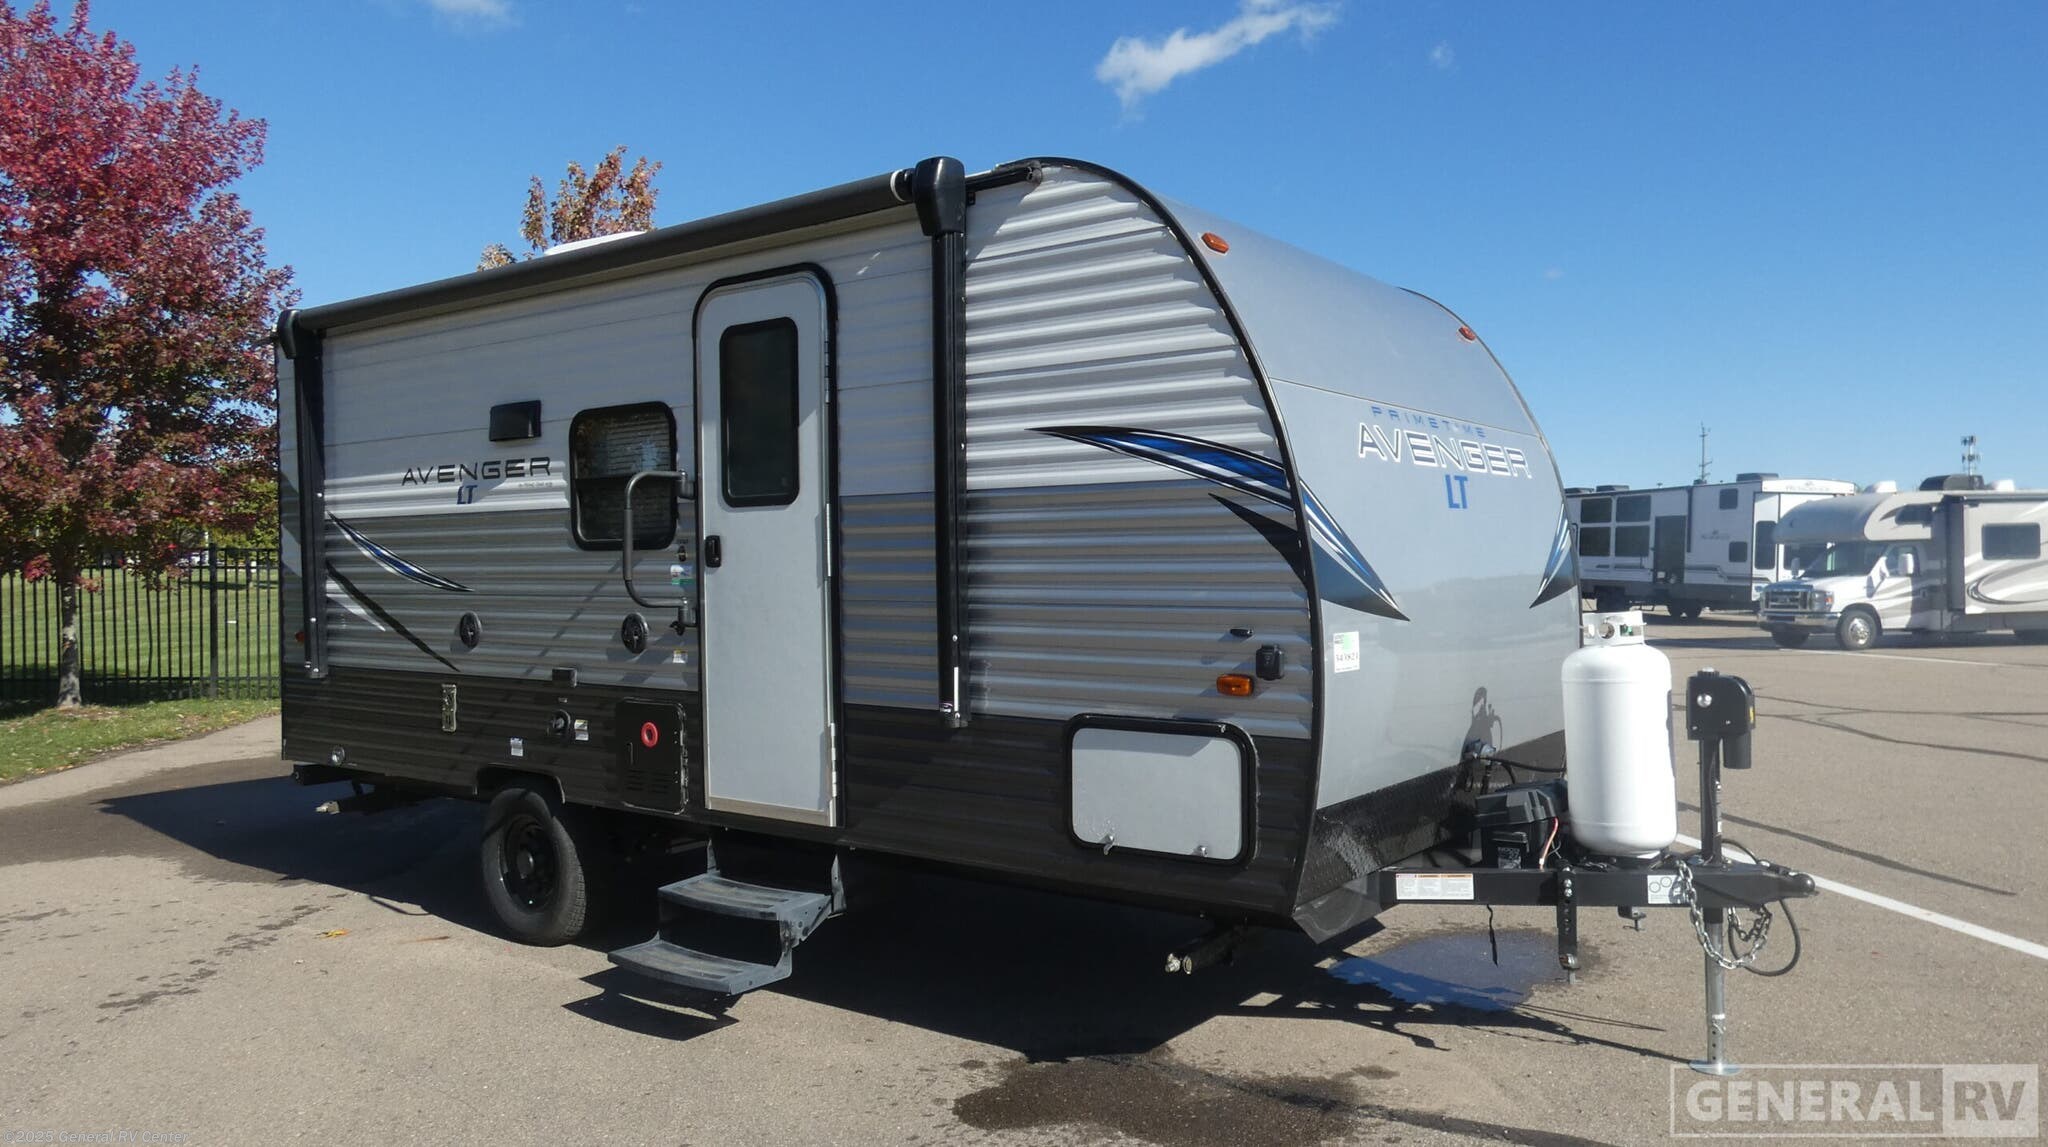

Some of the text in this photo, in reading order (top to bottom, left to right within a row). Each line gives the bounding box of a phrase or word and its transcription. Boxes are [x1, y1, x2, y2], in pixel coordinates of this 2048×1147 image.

[1358, 422, 1533, 480] AVENGER
[402, 457, 550, 485] AVENGER
[457, 484, 478, 505] LT
[1445, 474, 1469, 509] LT
